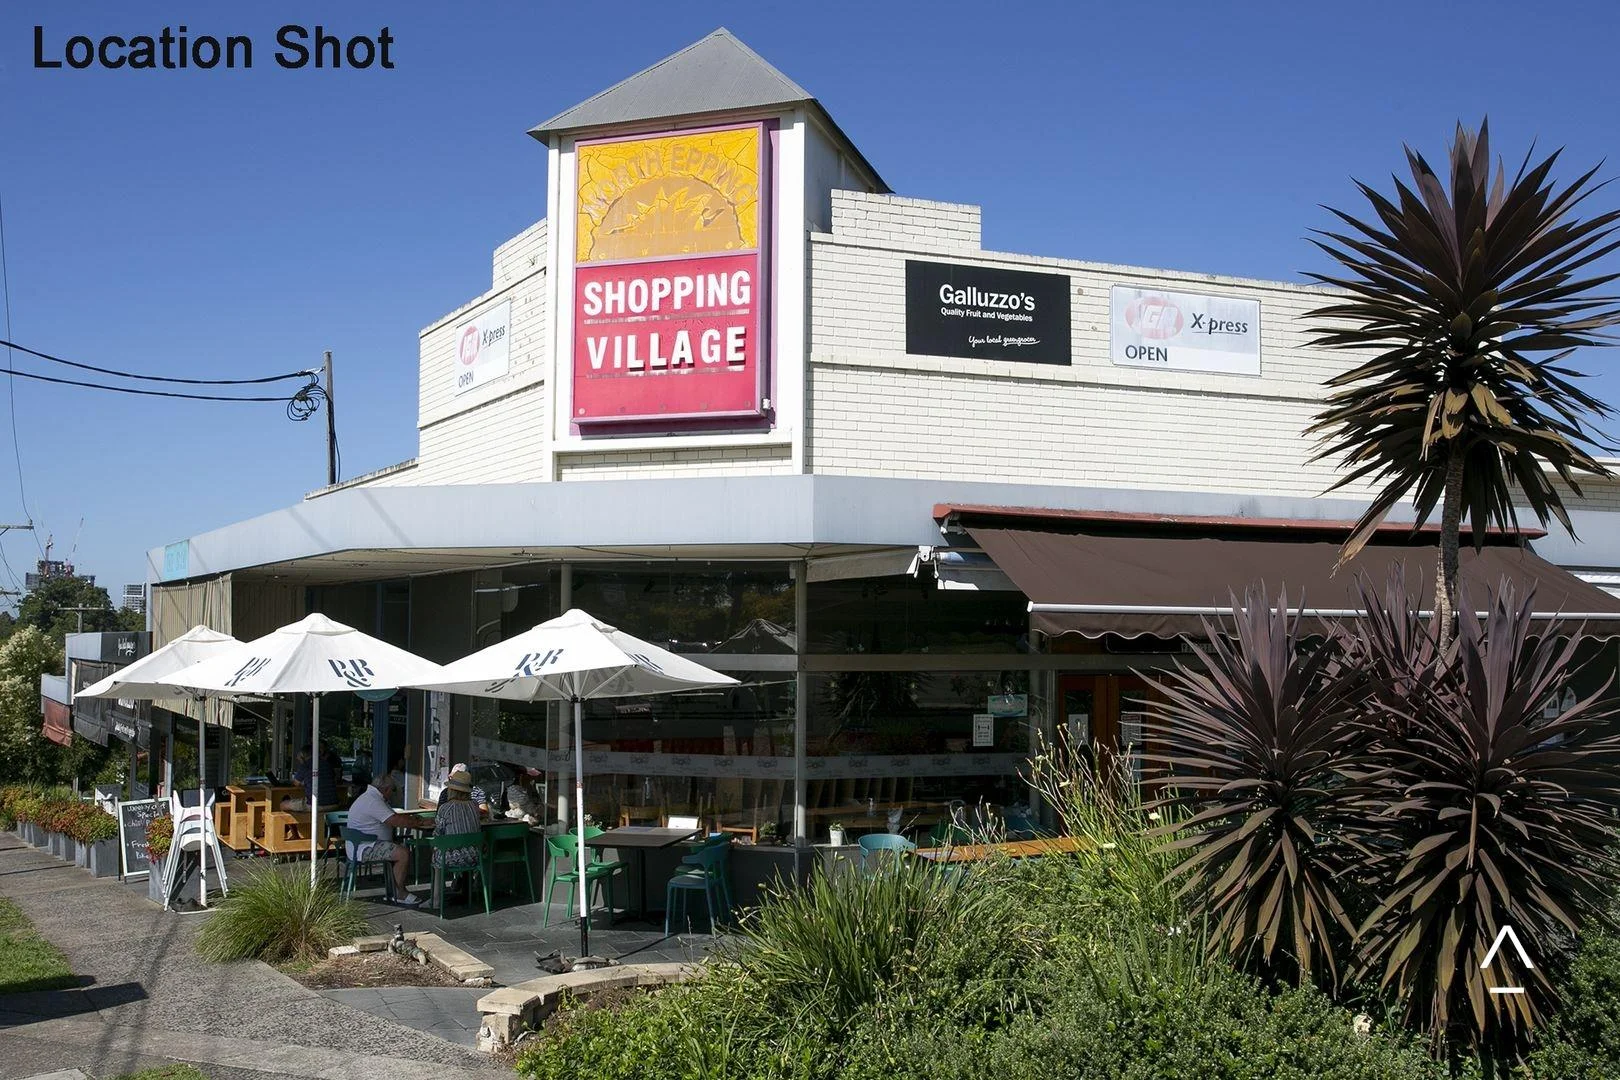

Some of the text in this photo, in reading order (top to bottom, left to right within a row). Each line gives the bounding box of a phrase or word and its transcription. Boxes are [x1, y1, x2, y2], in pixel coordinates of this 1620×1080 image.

[584, 270, 750, 316] SHOPPING
[940, 284, 1035, 311] Galluzzo's
[941, 307, 1033, 322] Quality Fruit and Vegetables
[1191, 312, 1248, 335] X-press
[482, 325, 505, 347] X-press
[968, 335, 1040, 348] Your local greengrocer
[586, 326, 746, 371] VILLAGE
[1125, 345, 1168, 361] OPEN
[458, 370, 474, 388] OPEN
